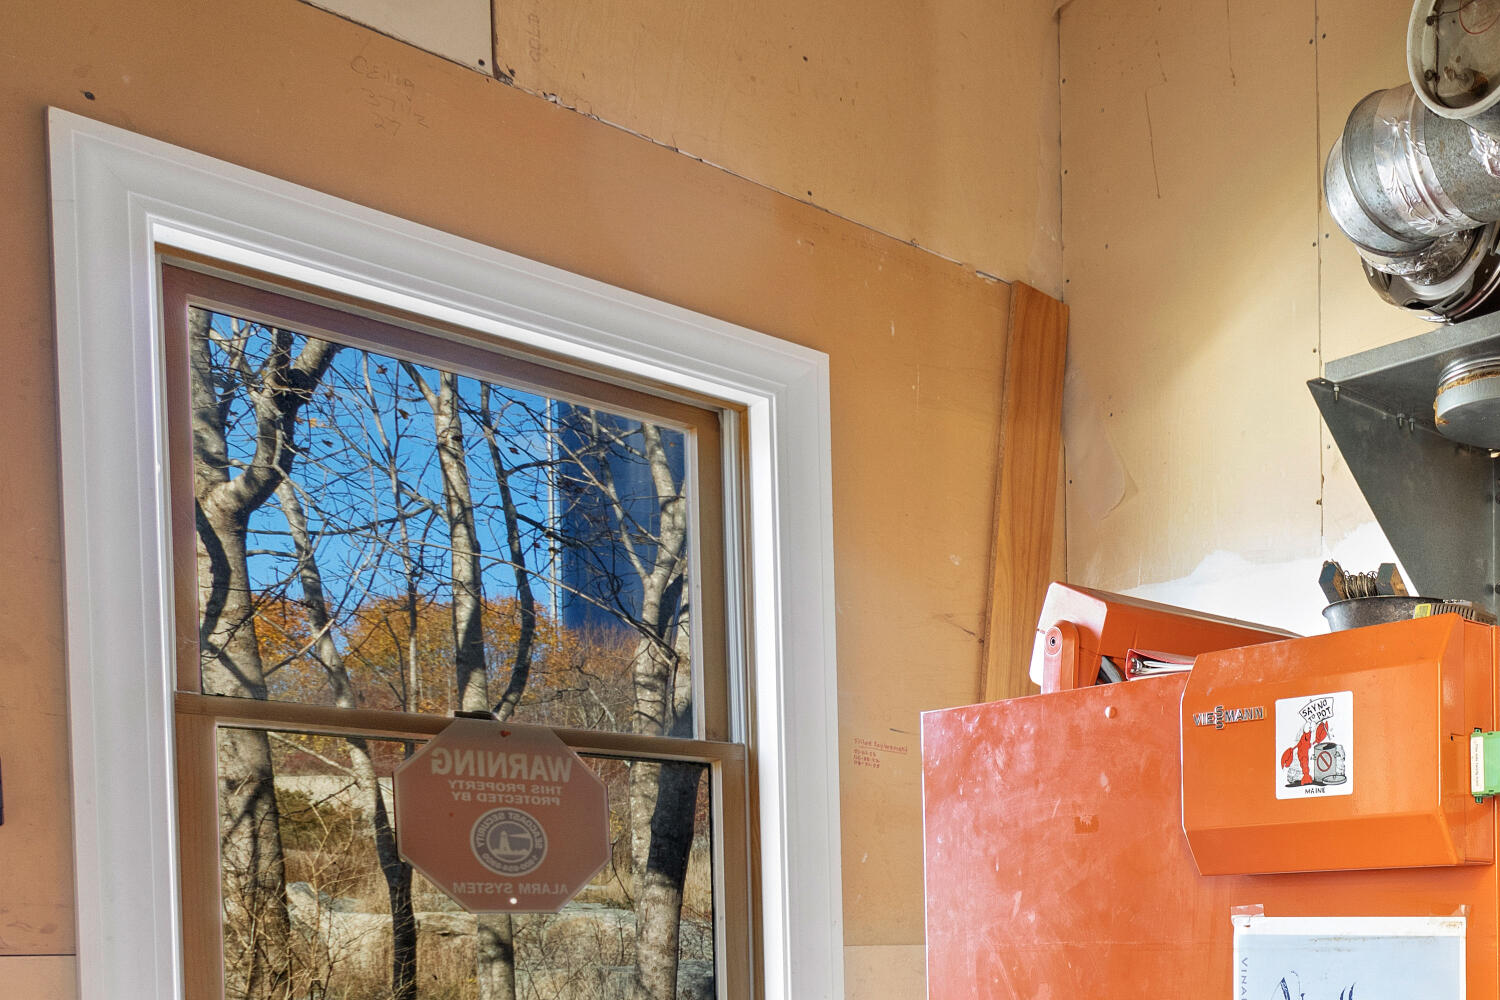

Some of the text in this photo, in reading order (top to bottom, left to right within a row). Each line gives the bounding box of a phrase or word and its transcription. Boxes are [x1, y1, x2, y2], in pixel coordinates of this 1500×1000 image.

[1302, 699, 1328, 718] SAY NO
[1308, 708, 1332, 722] TO POT
[1192, 705, 1265, 730] VIESSMANN
[1305, 787, 1326, 795] MAINE
